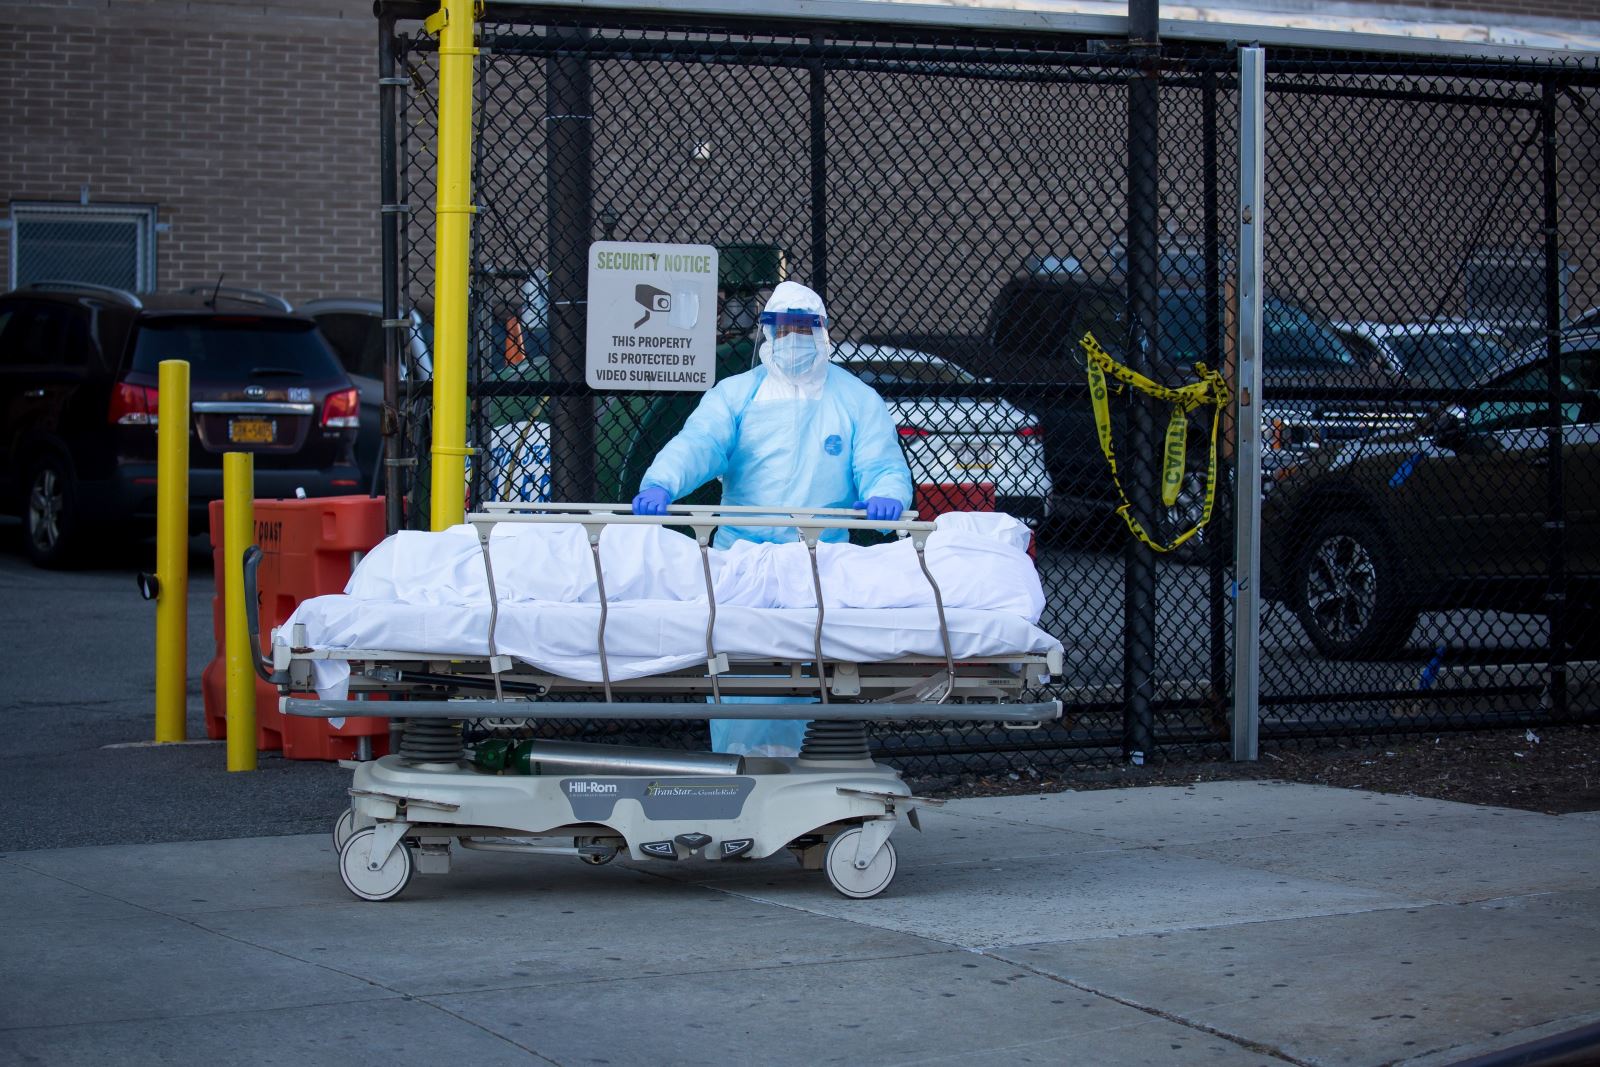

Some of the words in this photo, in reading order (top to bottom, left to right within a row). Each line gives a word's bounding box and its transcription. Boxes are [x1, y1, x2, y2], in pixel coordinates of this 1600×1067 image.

[597, 252, 660, 271] SECURITY
[664, 255, 711, 273] NOTICE
[612, 336, 635, 347] THIS
[638, 336, 692, 349] PROPERTY
[608, 353, 618, 364] IS
[621, 353, 679, 366] PROTECTED
[682, 355, 696, 366] BY
[596, 369, 627, 381] VIDEO
[630, 370, 706, 383] SURVEILLANCE
[258, 521, 282, 543] COAST
[569, 782, 617, 793] Hill-Rom
